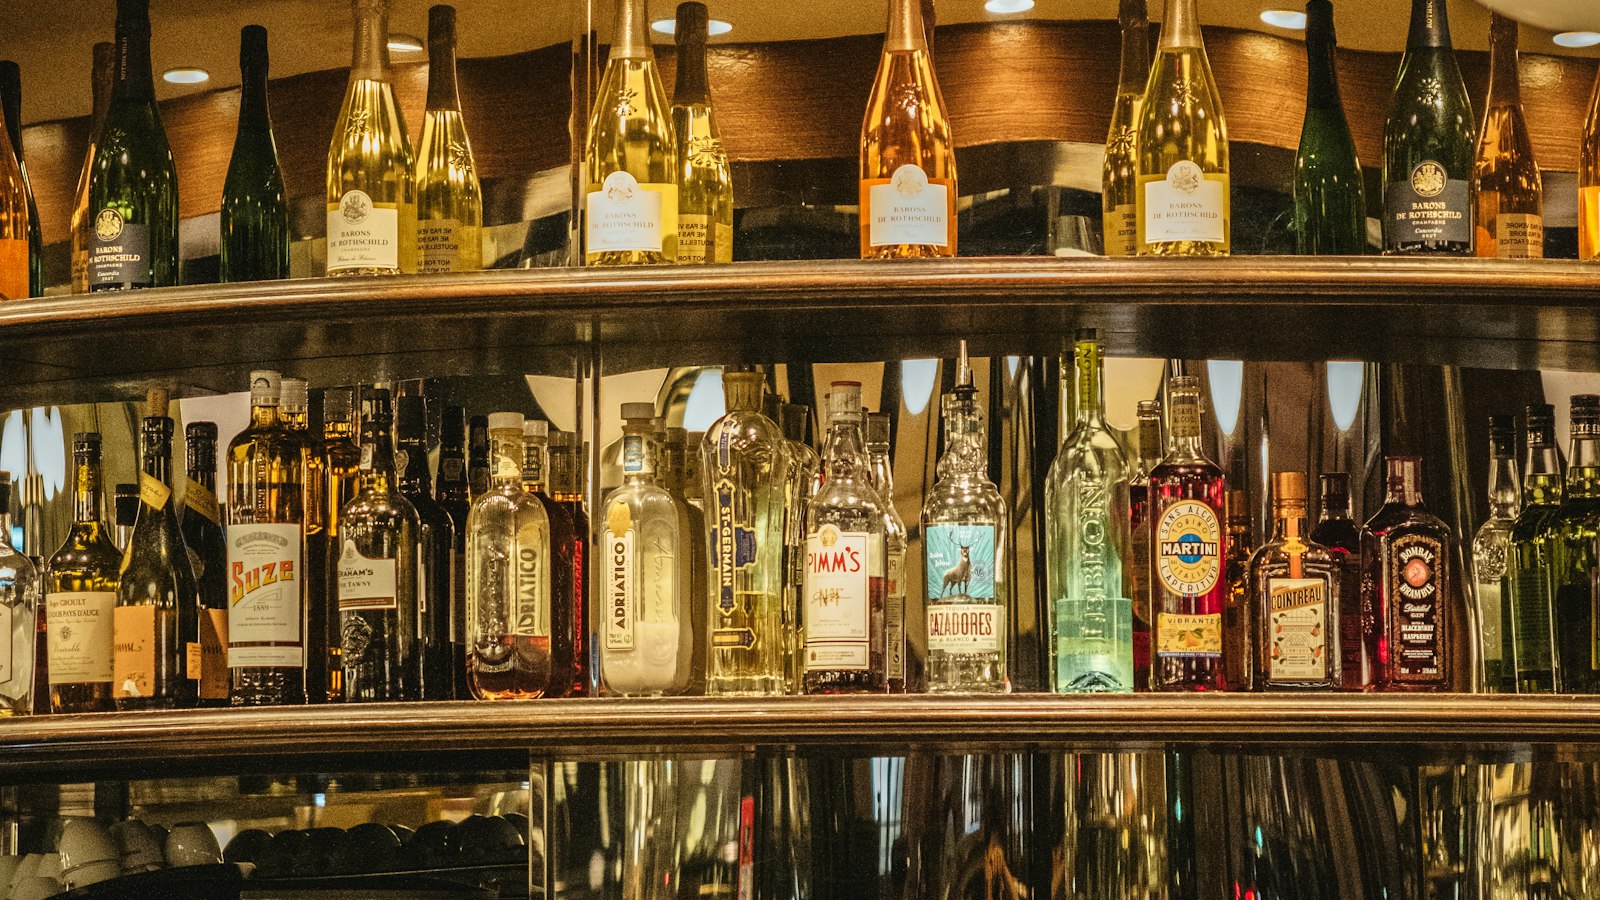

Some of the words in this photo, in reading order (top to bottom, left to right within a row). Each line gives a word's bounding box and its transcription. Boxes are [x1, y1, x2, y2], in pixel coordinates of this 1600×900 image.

[891, 215, 941, 223] ROTHSCHILD
[1409, 210, 1462, 219] ROTHSCHILD
[96, 246, 123, 254] BARONS
[94, 254, 140, 263] ROTHSCHILD
[1161, 508, 1181, 534] SANS
[1188, 505, 1217, 535] ALCOOL
[1172, 518, 1208, 533] TORINO
[721, 506, 732, 587] ST-GERMAIN
[1162, 542, 1217, 556] MARTINI
[808, 546, 860, 573] PIMM'S
[1399, 547, 1434, 563] BOMBAY
[1162, 566, 1217, 592] L'APERITIVO
[1173, 567, 1207, 579] ITALIA
[231, 560, 296, 608] Suze
[518, 548, 538, 634] ADRIATICO
[614, 542, 626, 630] ADRIATICO
[1400, 583, 1435, 599] BRAMBLE
[60, 599, 86, 607] GROULT
[1272, 585, 1321, 609] COINTREAU
[62, 609, 76, 617] PAYS
[930, 612, 993, 636] CAZADORES
